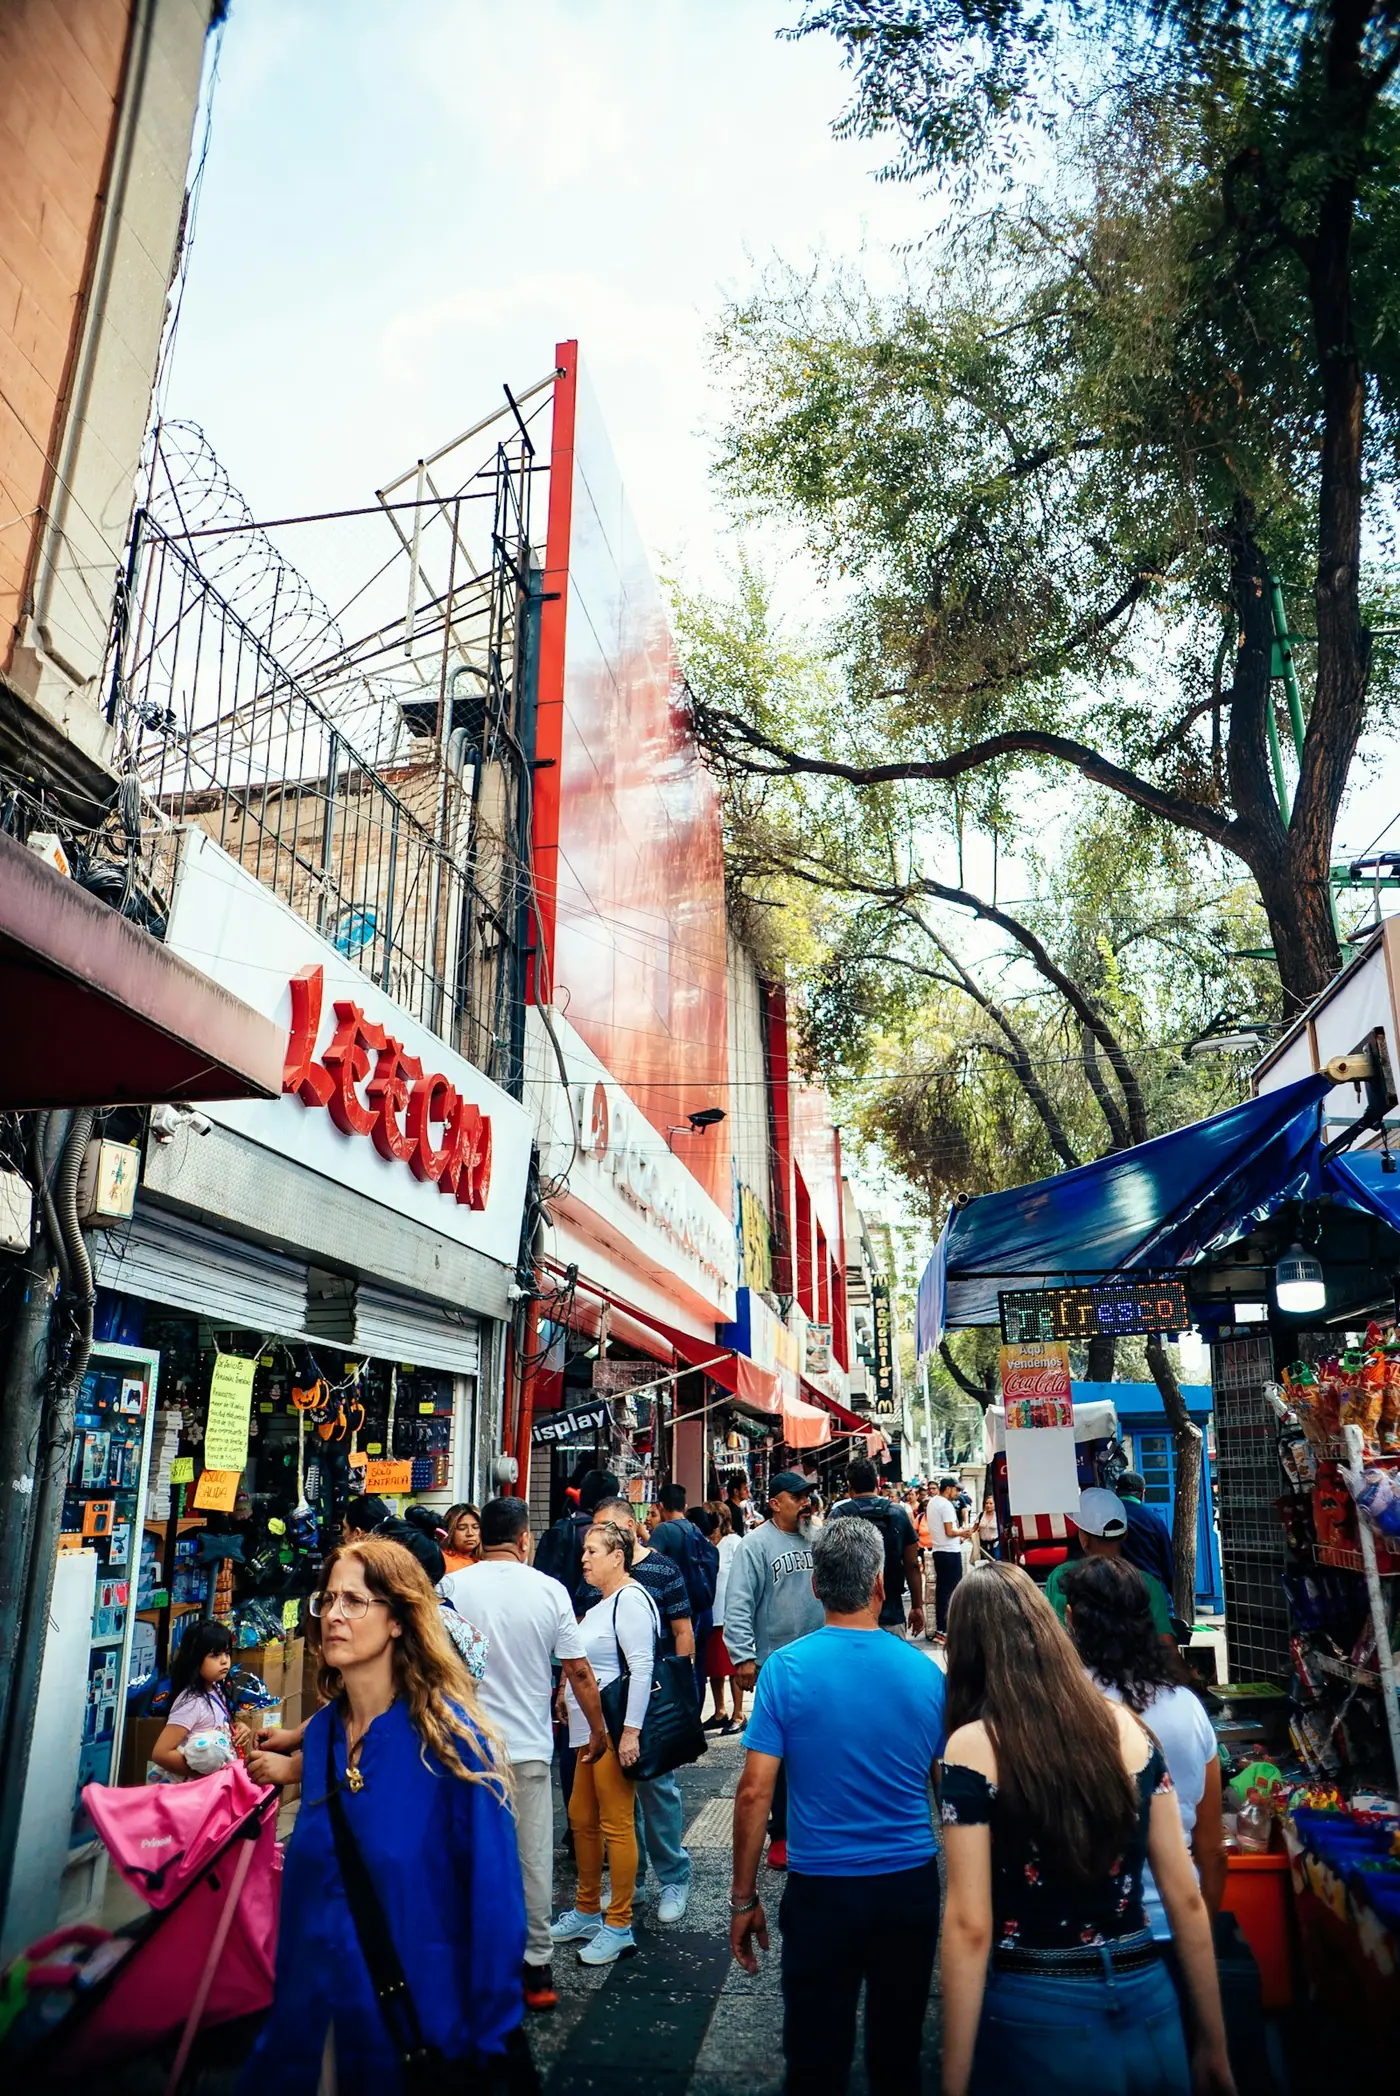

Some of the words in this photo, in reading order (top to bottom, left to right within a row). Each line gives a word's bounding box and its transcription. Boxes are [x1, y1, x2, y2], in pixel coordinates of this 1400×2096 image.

[531, 1409, 605, 1444] isplay
[371, 1467, 391, 1478] SOLO
[367, 1474, 409, 1486] ENTRADA
